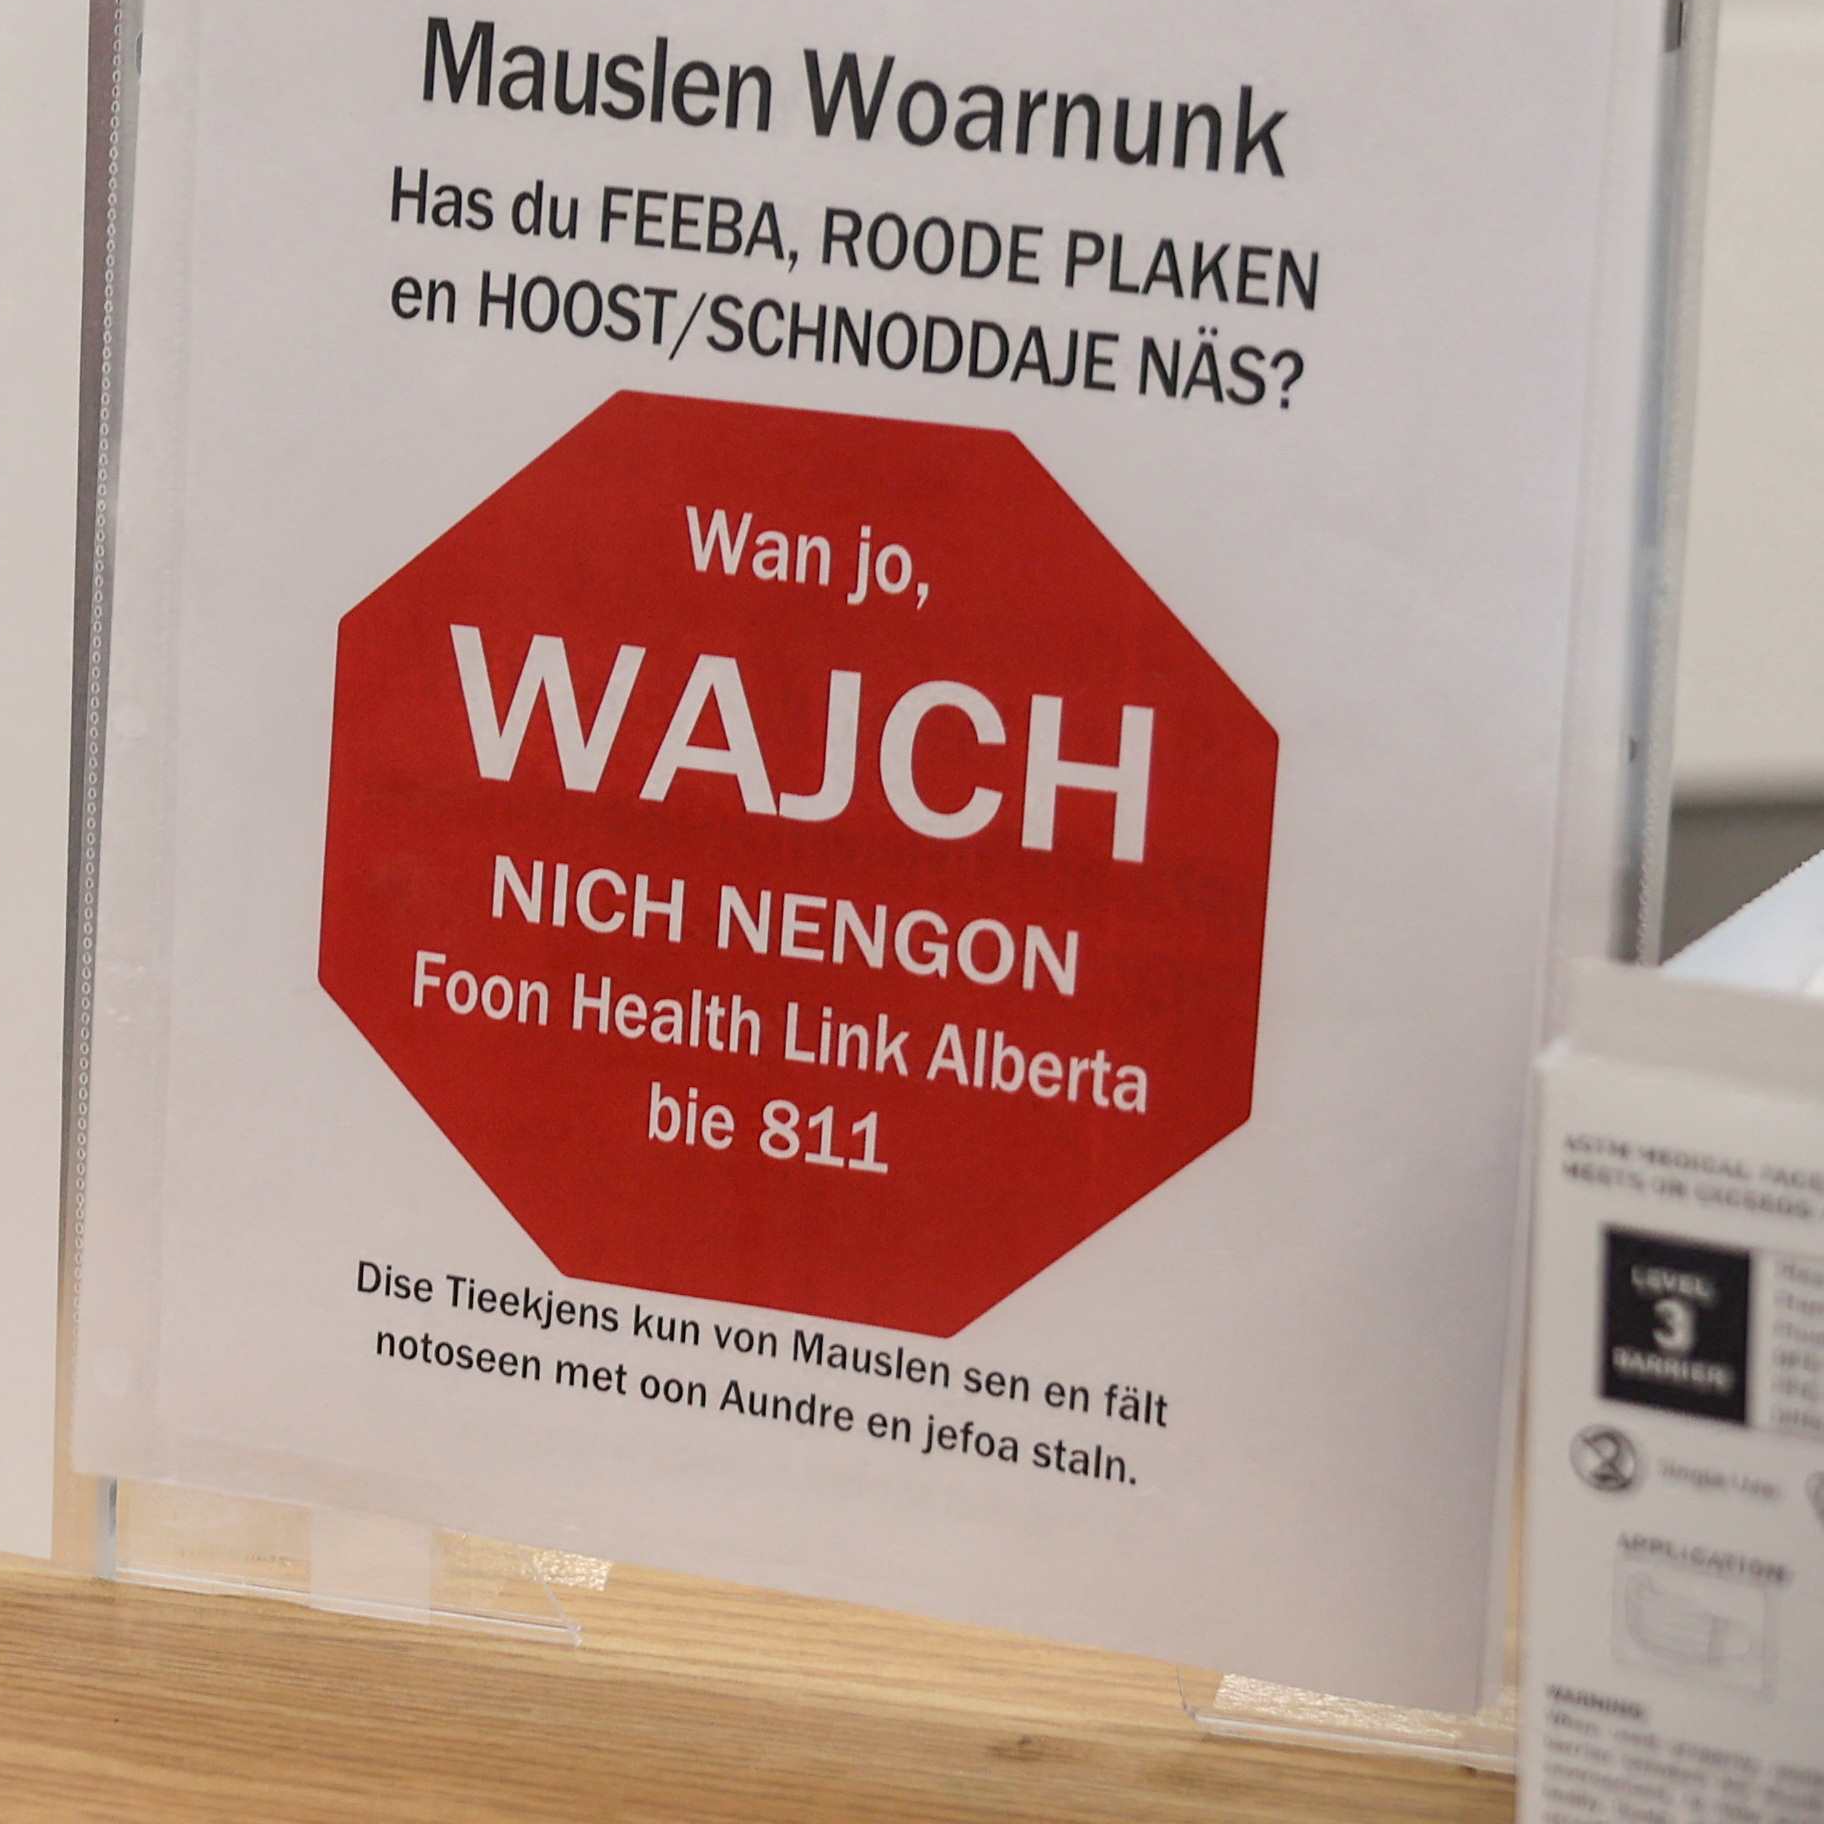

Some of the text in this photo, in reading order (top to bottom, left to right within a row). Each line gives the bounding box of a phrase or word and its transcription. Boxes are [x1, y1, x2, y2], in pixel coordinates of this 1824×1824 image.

[420, 15, 1290, 178] Mauslen Woarnunk
[389, 164, 1320, 313] Has du FEEBA, ROODE PLAKEN
[389, 270, 1306, 412] en HOOST/SCHNODDAJE NÄS?
[685, 504, 932, 610] Wan jo,
[449, 622, 1155, 865] WAJCH
[490, 854, 1080, 997] NICH NENGON
[412, 950, 1150, 1115] Foon Health Link Alberta
[646, 1080, 889, 1175] bie 811
[356, 1259, 1168, 1429] Dise Tieekjens kun von Mauslen sen en fält
[1629, 1263, 1718, 1305] LEVEL
[1651, 1297, 1699, 1356] 3
[375, 1328, 1138, 1487] notoseen met oon Aundre en jefoa staln.
[1611, 1346, 1737, 1397] BARRIER
[1617, 1531, 1790, 1586] APPLICATION
